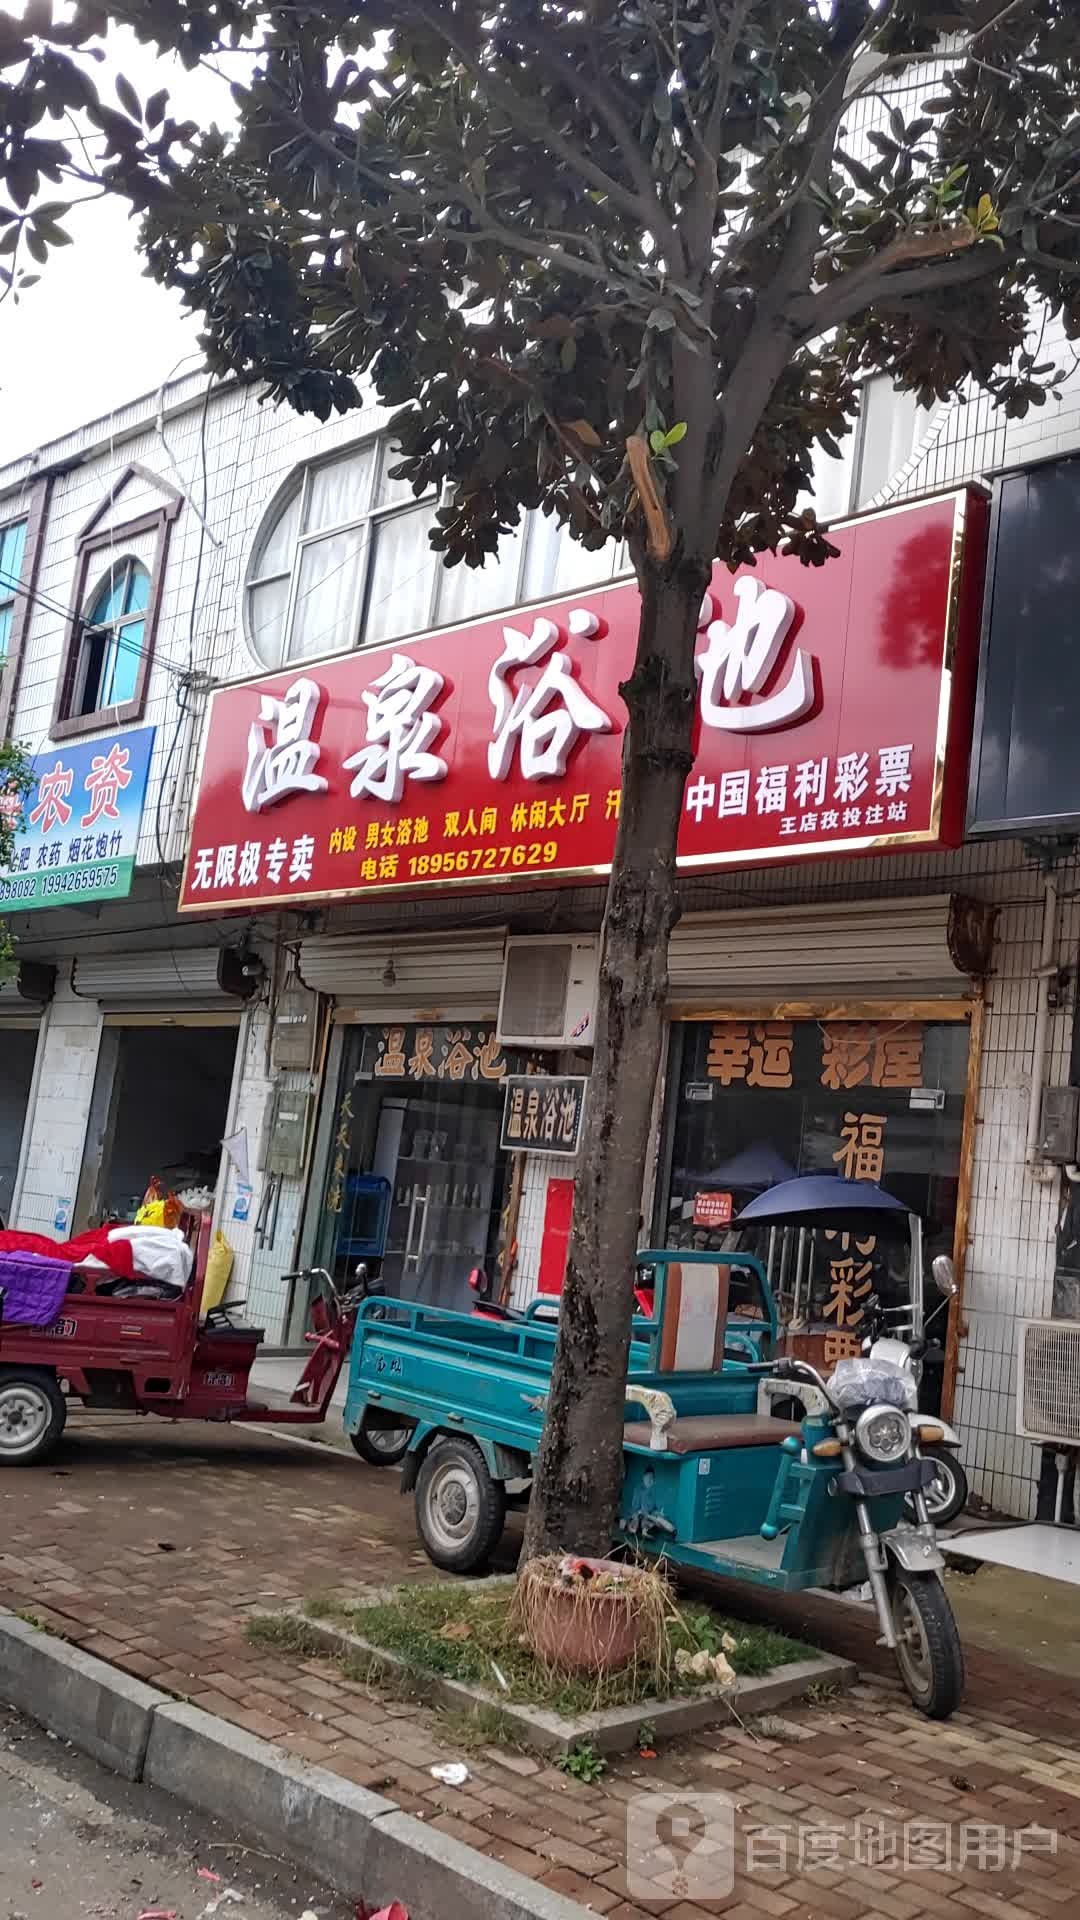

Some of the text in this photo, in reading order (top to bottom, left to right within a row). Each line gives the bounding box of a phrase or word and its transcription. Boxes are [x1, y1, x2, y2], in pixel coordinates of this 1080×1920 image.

[241, 574, 816, 814] 温泉浴池
[29, 743, 133, 835] 农资
[685, 742, 915, 823] 中国福利彩票
[329, 826, 358, 855] 内设
[364, 817, 430, 850] 男女浴池
[443, 806, 498, 839] 双人间
[510, 793, 590, 834] 休闲大厅
[778, 801, 908, 836] 王店孜投注站
[36, 840, 62, 869] 农药
[67, 829, 123, 864] 烟花炮竹
[190, 833, 315, 891] 无限极专卖
[360, 841, 559, 881] 电话 18956727629
[42, 864, 119, 896] 19942659575
[374, 1027, 508, 1081] 温泉浴池
[706, 1021, 794, 1089] 幸运
[506, 1087, 577, 1143] 温泉浴池
